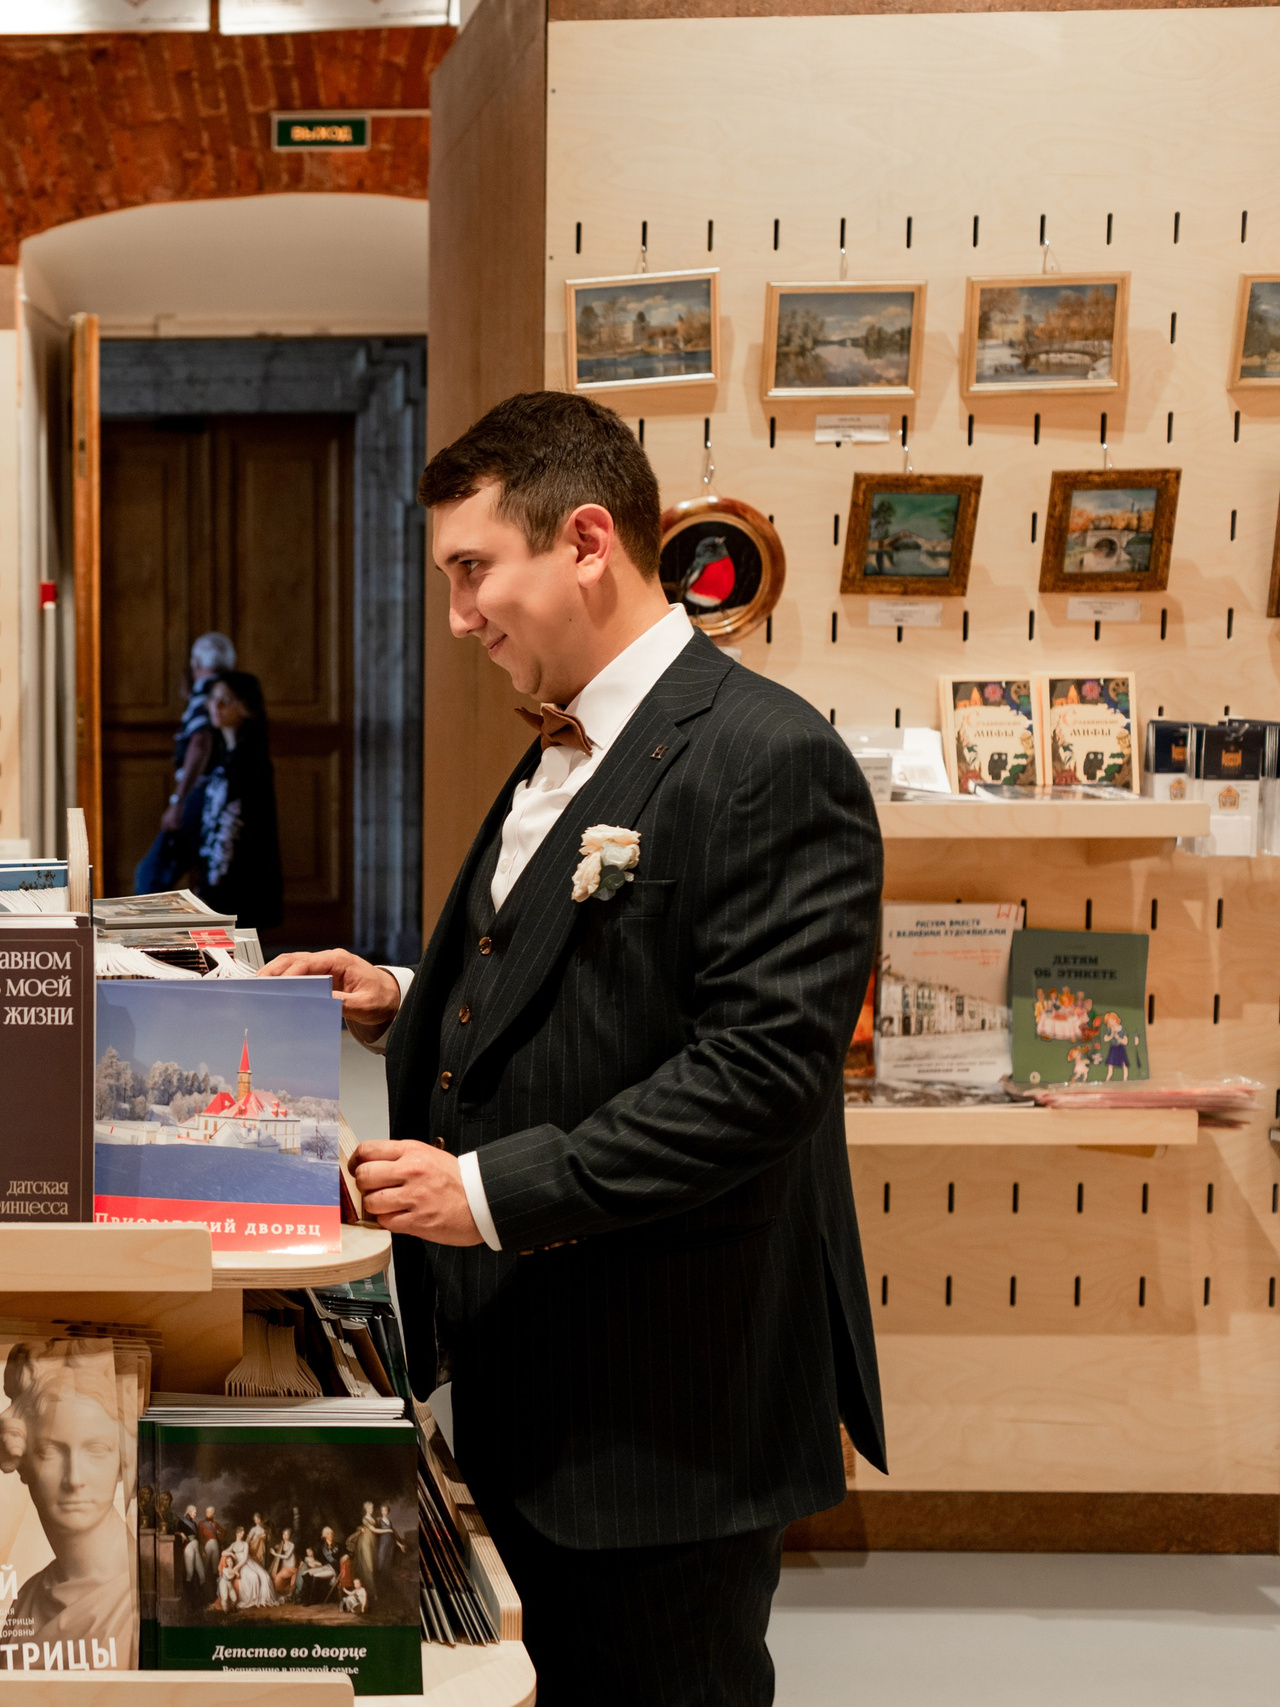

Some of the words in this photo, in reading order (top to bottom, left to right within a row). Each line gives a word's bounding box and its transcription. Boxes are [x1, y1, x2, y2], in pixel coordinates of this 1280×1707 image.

[5, 975, 73, 998] МОЕЙ
[2, 1006, 75, 1026] ЖИЗНИ
[6, 1180, 70, 1197] ДАТСКАЯ
[0, 1607, 16, 1616] ДНЯ
[211, 1645, 287, 1661] Детство
[289, 1647, 309, 1658] во
[312, 1644, 368, 1661] дворце
